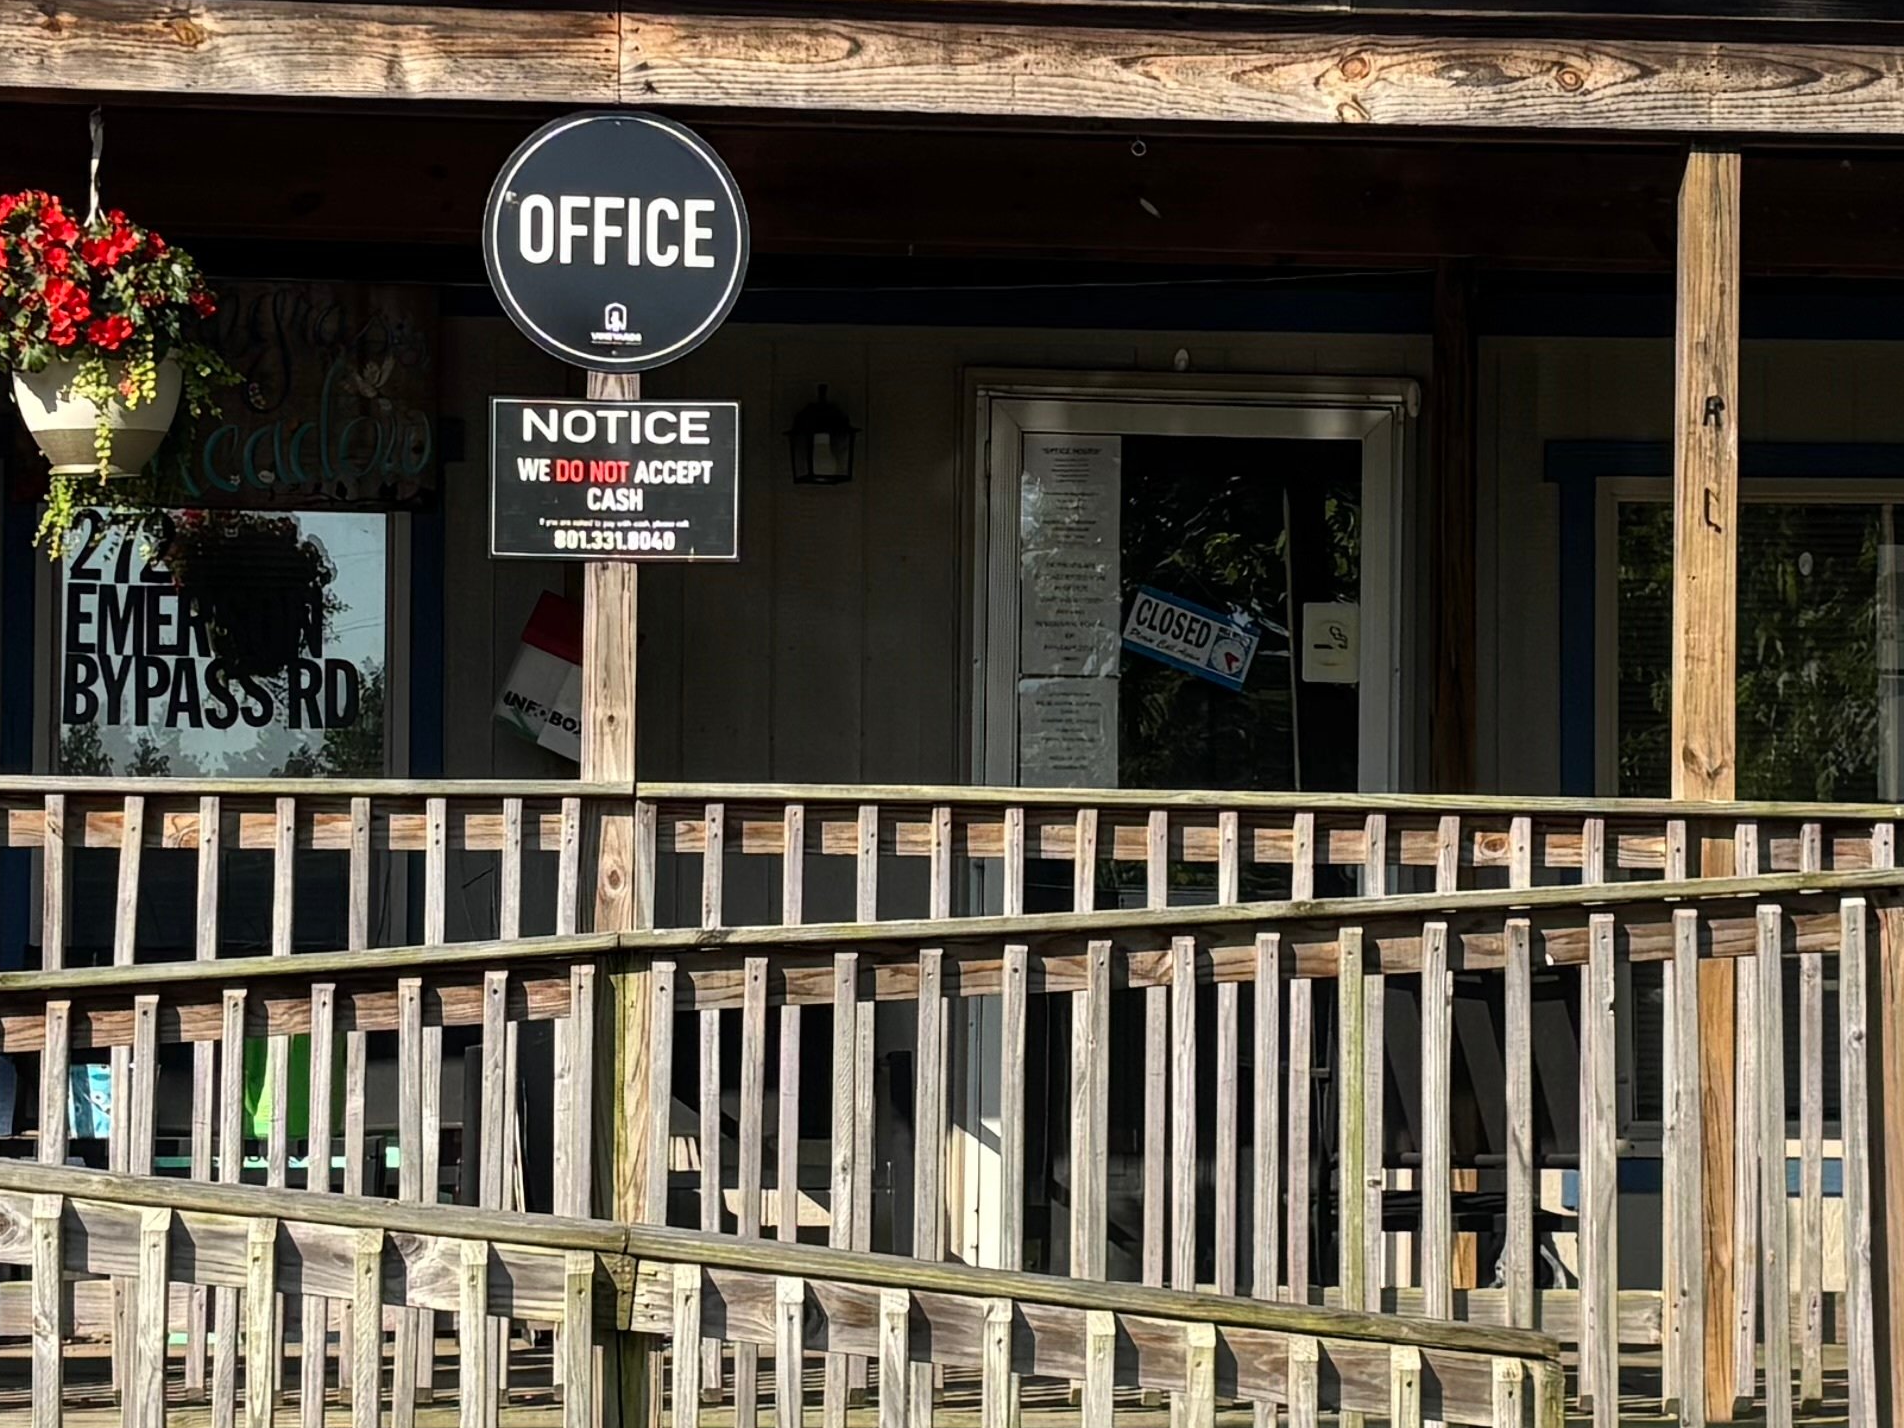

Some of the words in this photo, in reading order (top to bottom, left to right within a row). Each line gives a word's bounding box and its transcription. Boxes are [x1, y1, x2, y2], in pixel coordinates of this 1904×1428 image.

[519, 193, 715, 268] OFFICE
[166, 350, 432, 499] eadow
[522, 408, 711, 445] NOTICE
[516, 457, 551, 482] WE
[555, 458, 584, 483] DO
[589, 459, 630, 483] NOT
[634, 460, 713, 484] ACCEPT
[586, 487, 643, 512] CASH
[554, 529, 676, 551] 801.331.8040
[66, 583, 323, 659] EMERN
[1135, 598, 1212, 649] CLOSED
[63, 652, 274, 730] BYPASS
[288, 657, 360, 730] RD
